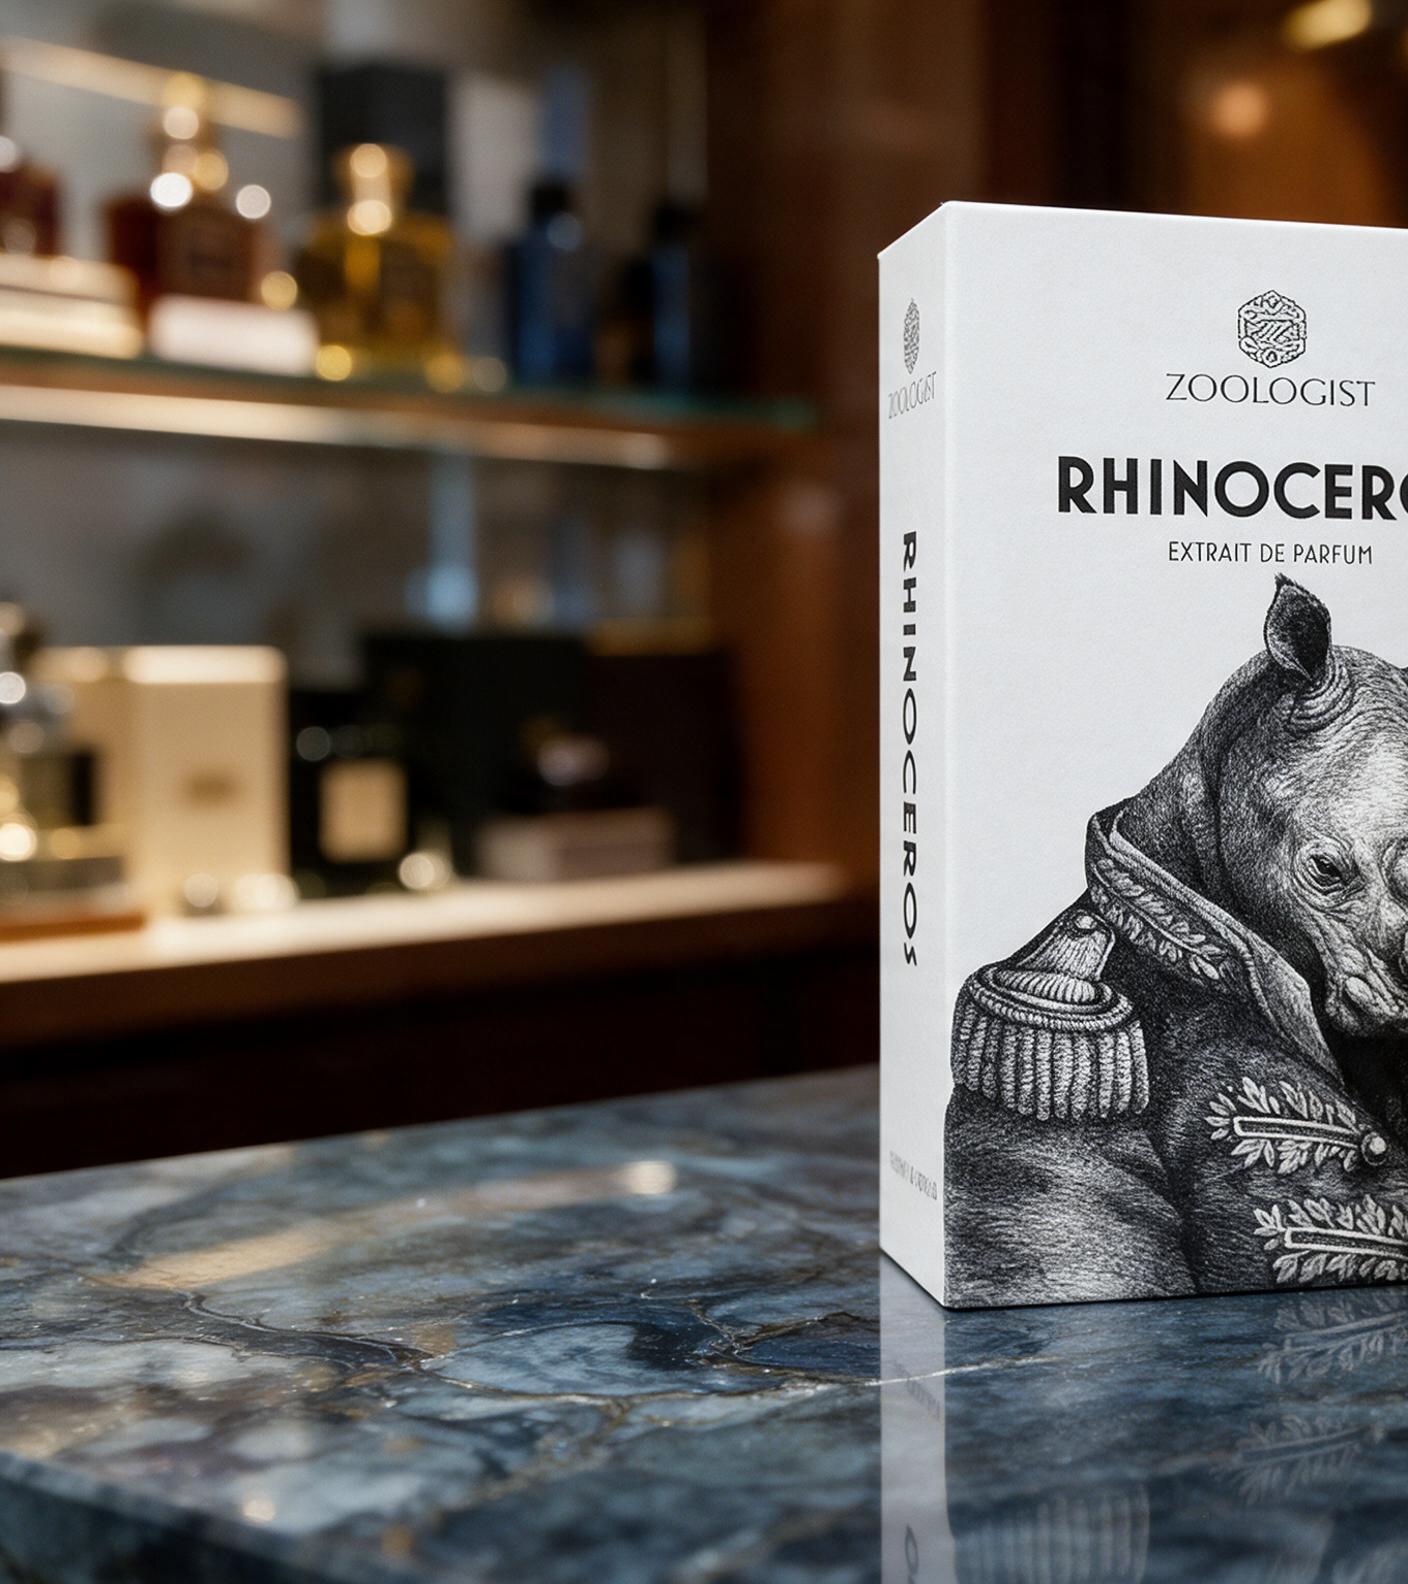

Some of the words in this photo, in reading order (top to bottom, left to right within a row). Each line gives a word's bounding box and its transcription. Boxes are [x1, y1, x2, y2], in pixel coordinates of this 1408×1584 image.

[1165, 373, 1376, 407] ZOOLOGIST
[1168, 541, 1252, 562] EXTRAIT
[1260, 543, 1285, 563] DE
[1293, 544, 1373, 565] PARFUM
[902, 531, 918, 967] RHINOCEROS
